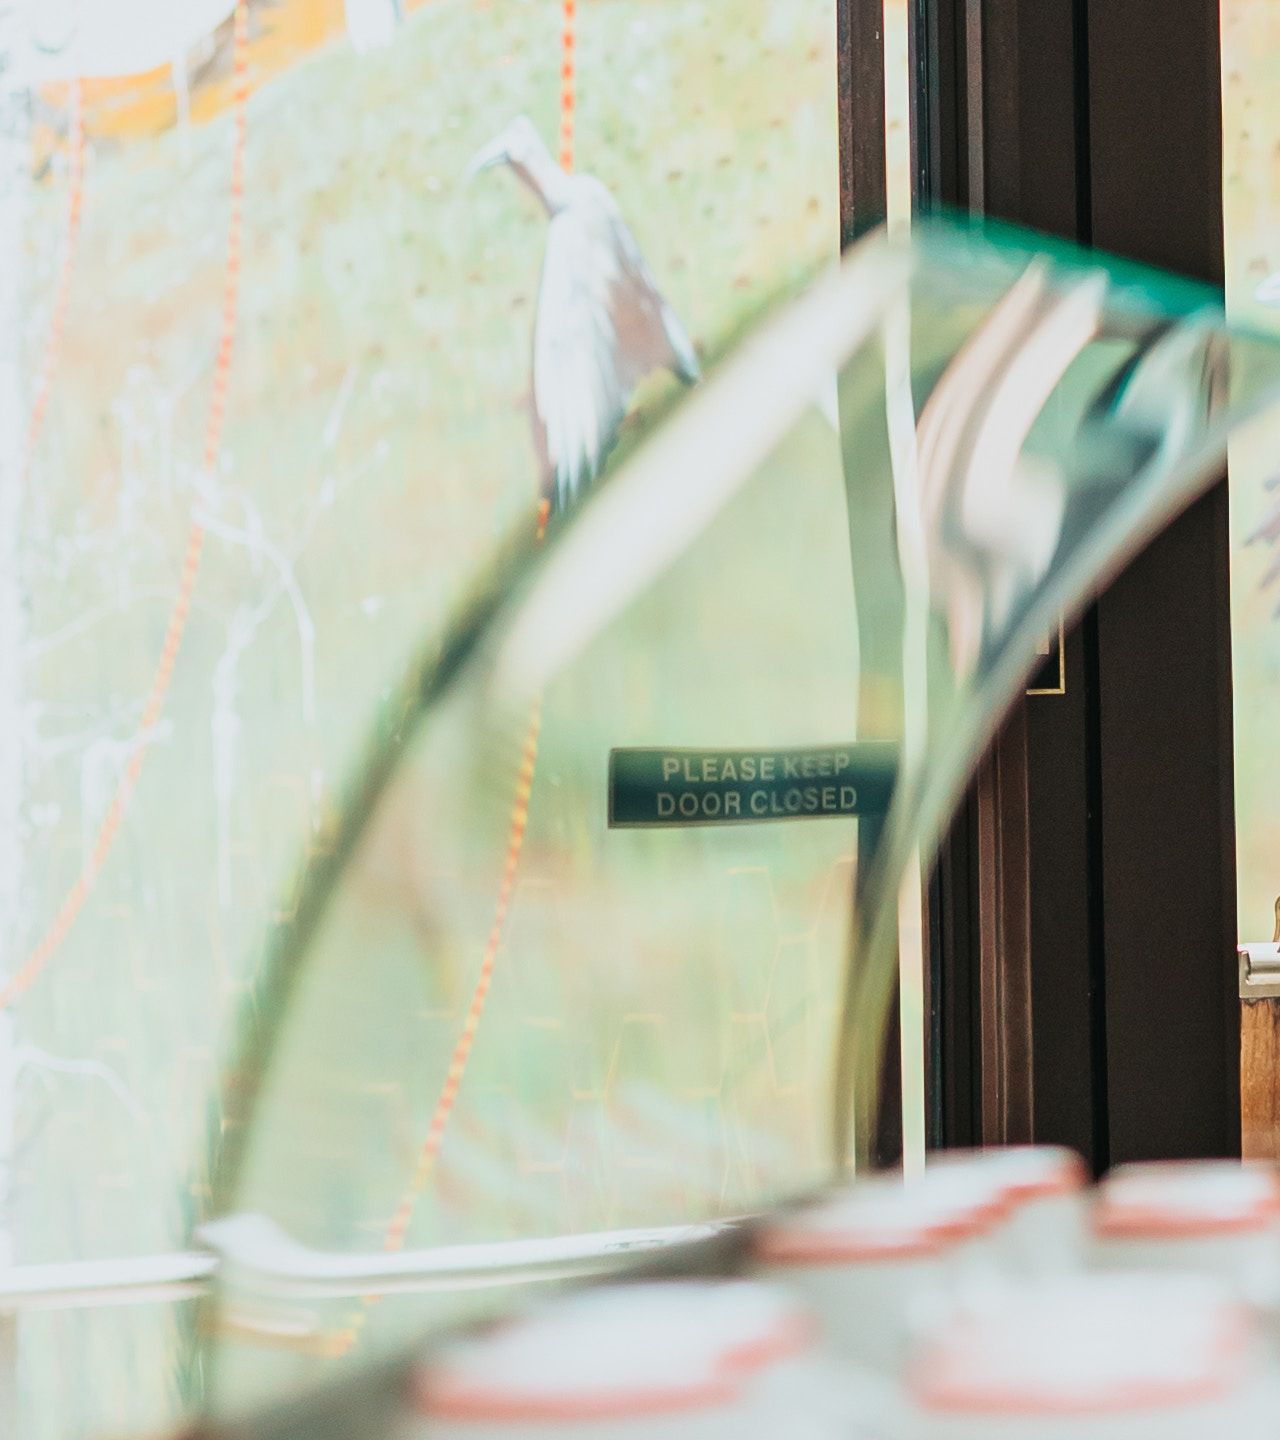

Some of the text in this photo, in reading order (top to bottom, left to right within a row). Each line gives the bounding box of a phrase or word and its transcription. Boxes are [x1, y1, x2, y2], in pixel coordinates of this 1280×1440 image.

[661, 752, 850, 782] PLEASE KEEP
[656, 786, 858, 816] DOOR CLOSED
